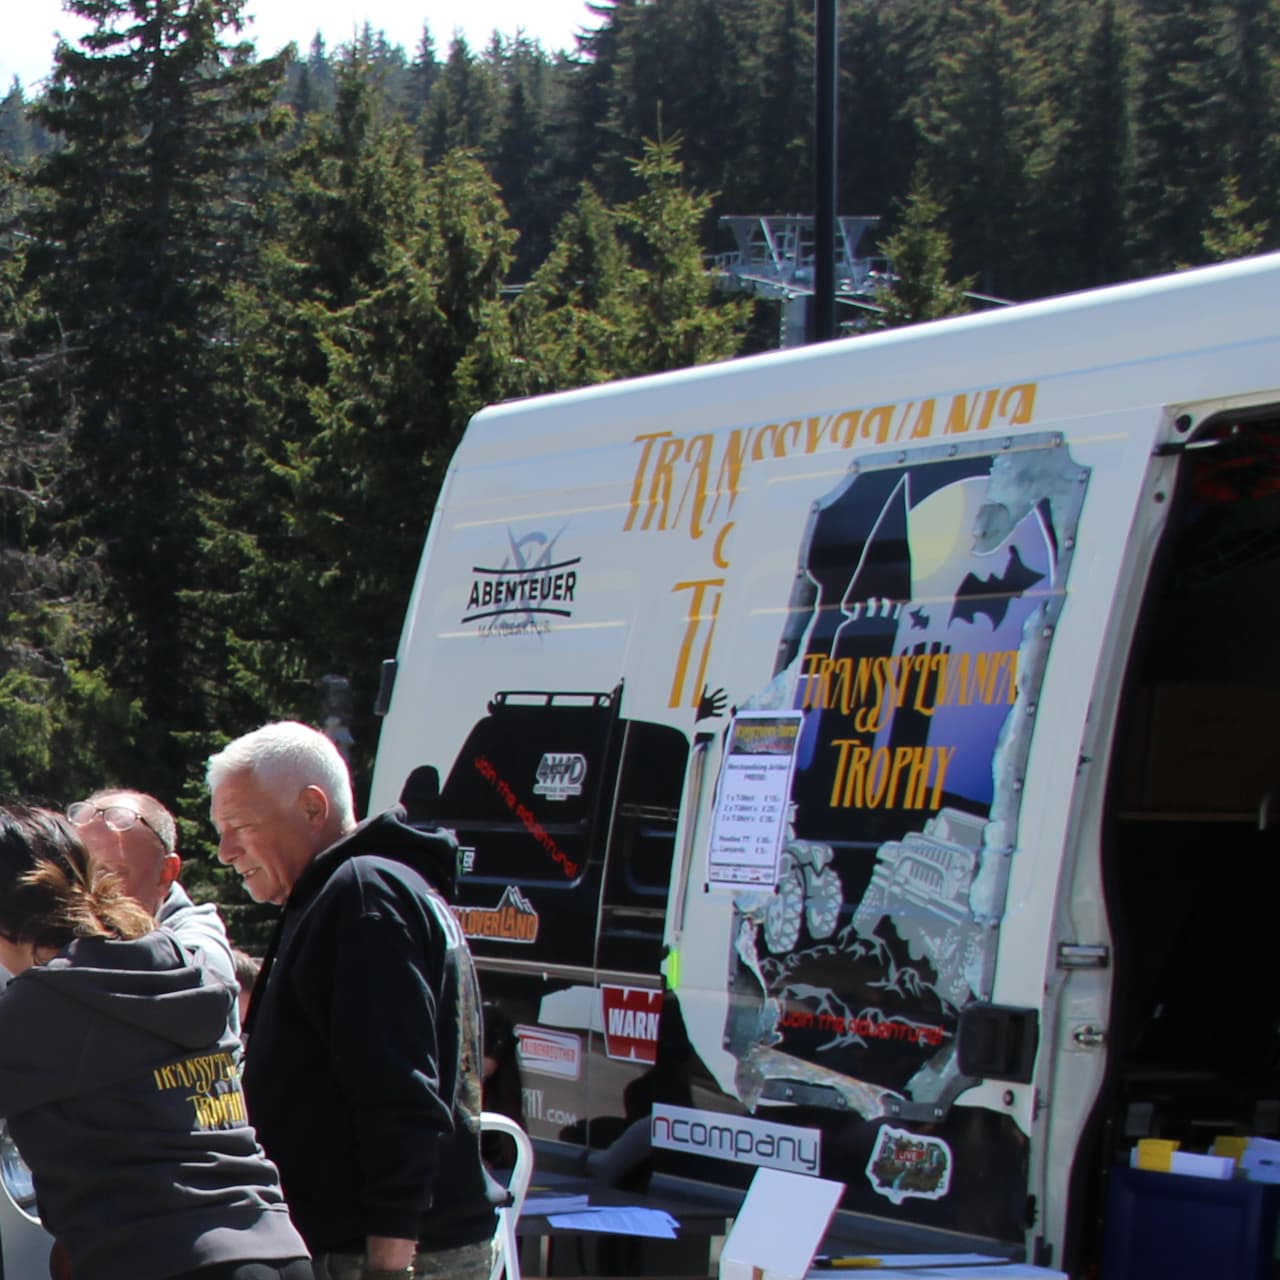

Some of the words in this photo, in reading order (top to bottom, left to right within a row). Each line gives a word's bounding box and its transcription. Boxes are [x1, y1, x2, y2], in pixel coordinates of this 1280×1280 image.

[467, 571, 576, 610] ABENTEUER
[803, 651, 1019, 732] TRANSSYLVANIA
[829, 740, 956, 811] TROPHY
[608, 1008, 660, 1041] WARN
